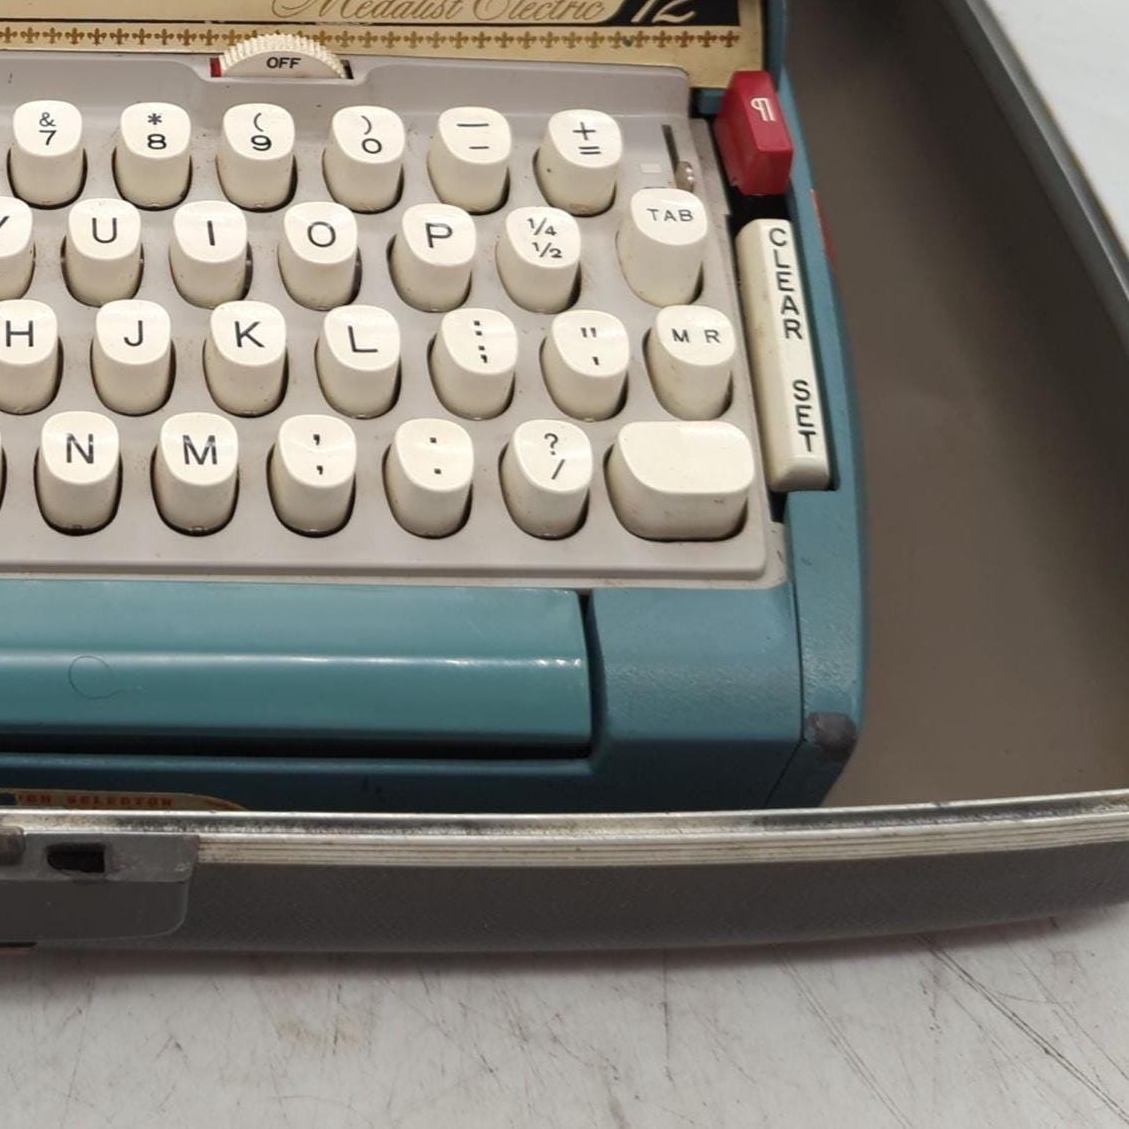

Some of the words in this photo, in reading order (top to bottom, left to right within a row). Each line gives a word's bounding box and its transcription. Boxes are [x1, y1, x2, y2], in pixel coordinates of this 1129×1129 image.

[266, 56, 302, 69] OFF
[38, 111, 57, 128] &
[253, 112, 264, 133] (
[360, 115, 373, 136] )
[572, 121, 597, 141] +
[39, 129, 57, 146] 7
[147, 133, 167, 150] 8
[250, 134, 272, 152] 9
[361, 137, 383, 155] 0
[646, 208, 694, 223] TAB
[91, 217, 118, 244] U
[206, 220, 216, 247] I
[307, 221, 337, 248] O
[425, 222, 453, 249] P
[769, 227, 803, 340] CLEAR
[5, 320, 34, 348] H
[123, 319, 144, 347] J
[234, 320, 265, 348] K
[347, 325, 379, 354] L
[792, 379, 817, 453] SET
[66, 433, 95, 465] N
[182, 434, 218, 466] M
[543, 432, 559, 456] ?
